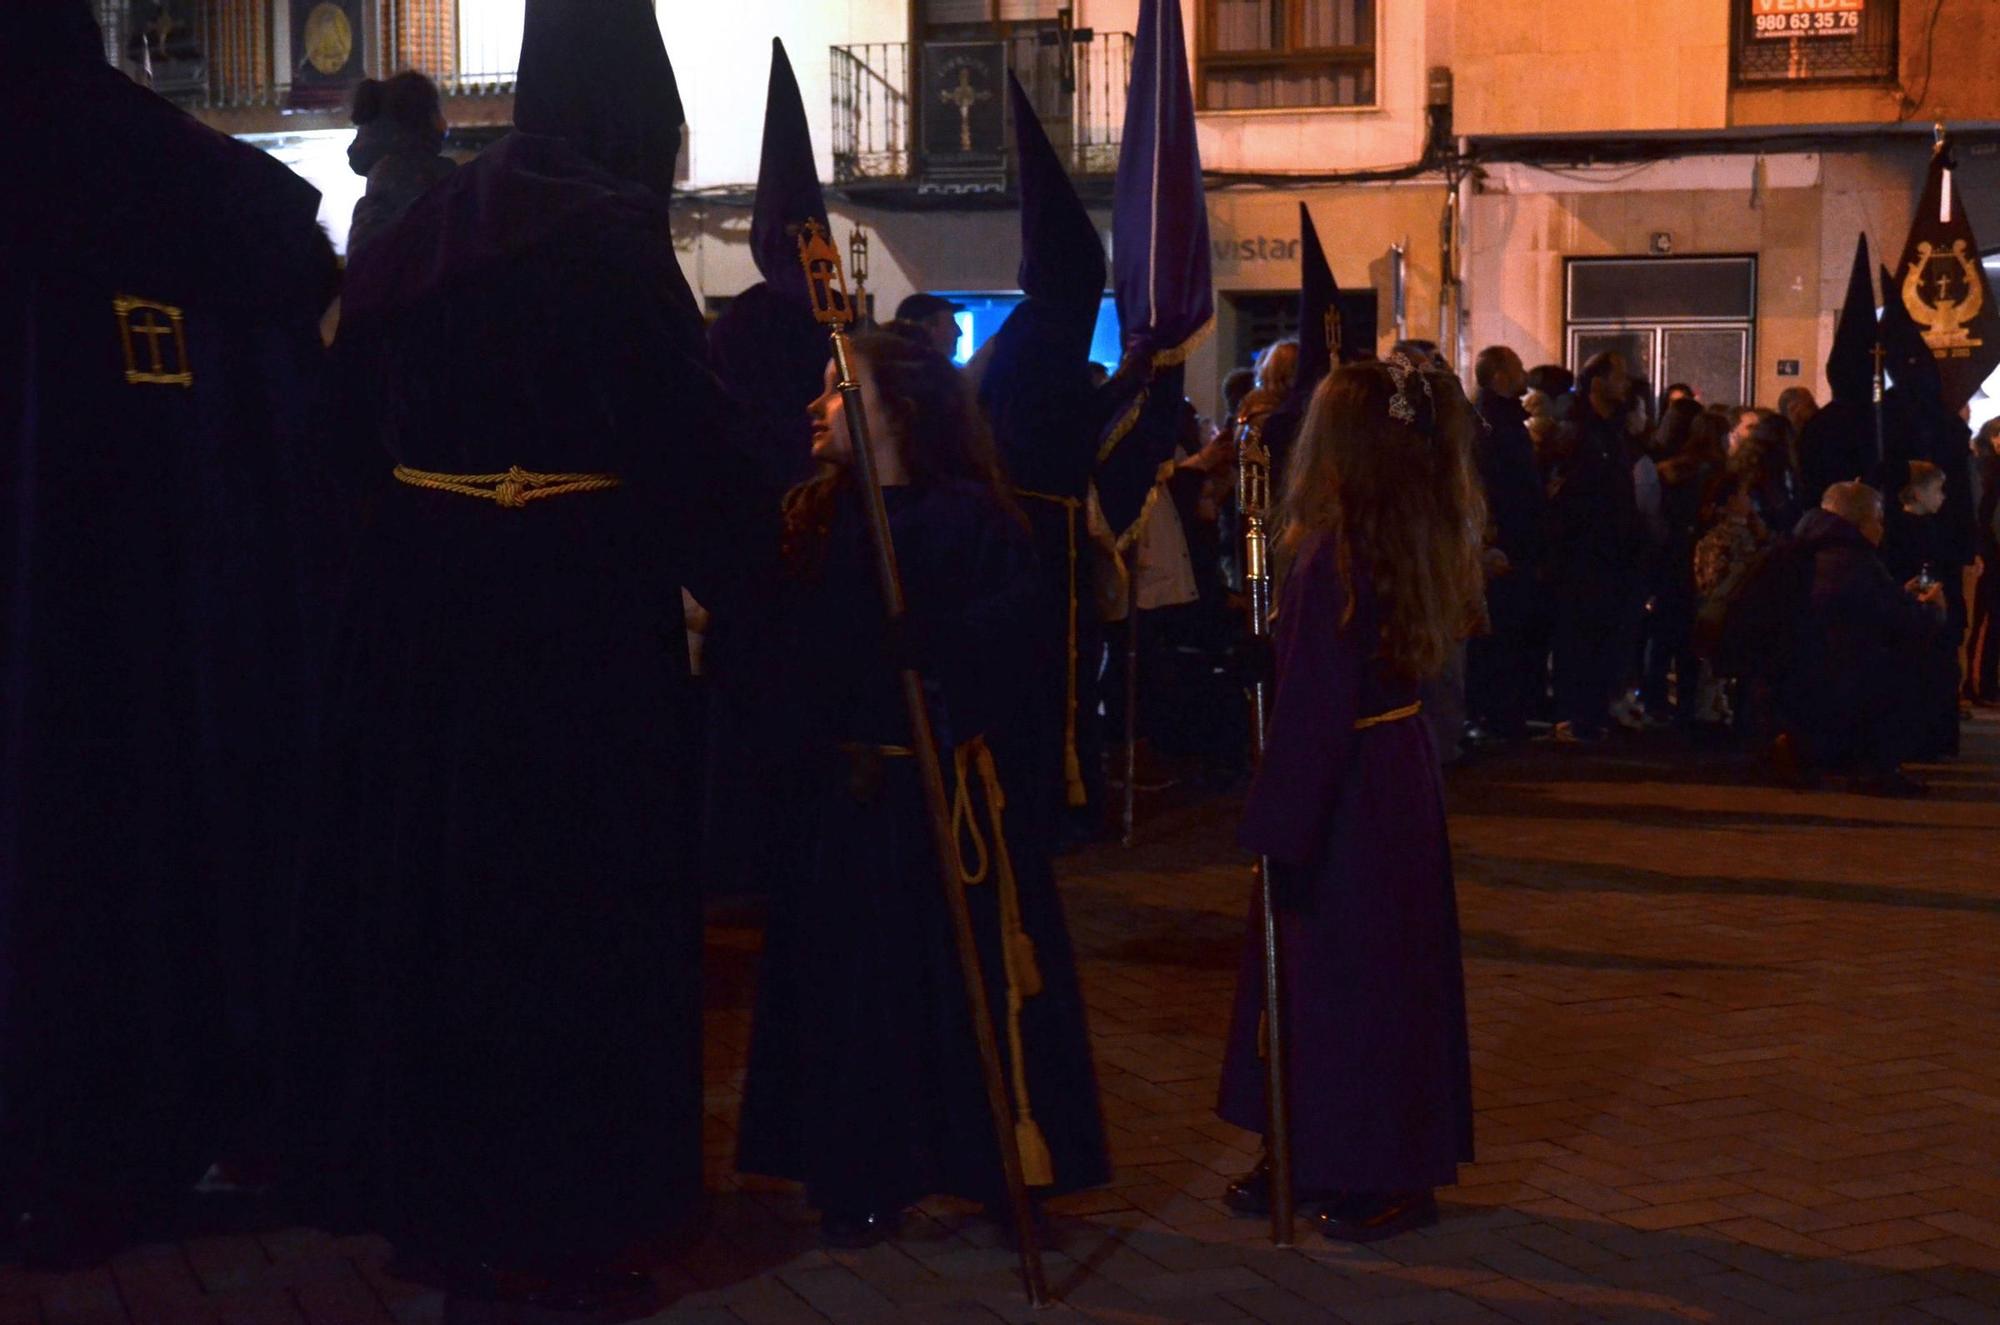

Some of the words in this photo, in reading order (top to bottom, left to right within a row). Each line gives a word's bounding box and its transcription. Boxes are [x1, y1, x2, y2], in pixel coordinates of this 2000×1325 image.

[1756, 14, 1786, 30] 980
[1790, 13, 1810, 29] 63
[1814, 12, 1834, 28] 35
[1838, 11, 1858, 27] 76
[1213, 234, 1299, 260] vistar
